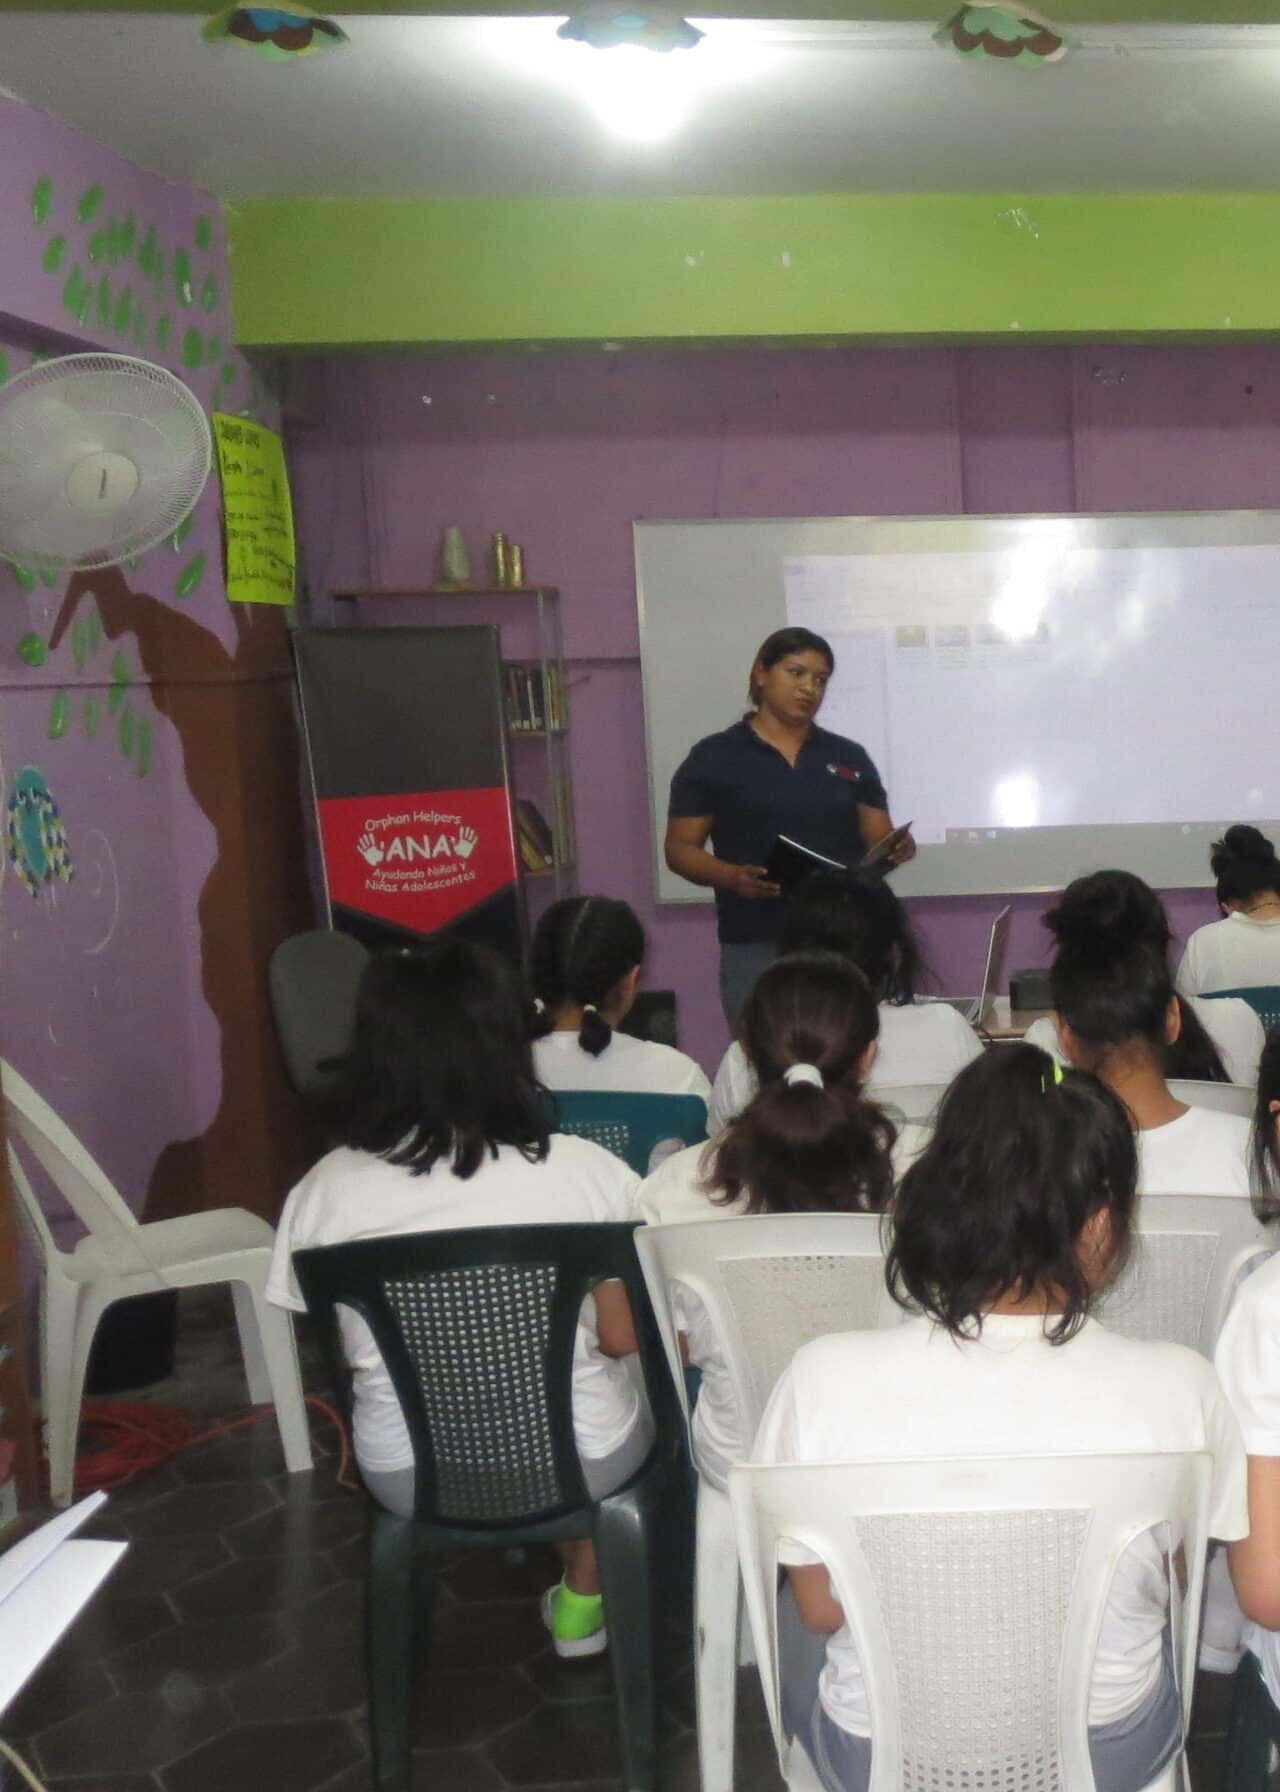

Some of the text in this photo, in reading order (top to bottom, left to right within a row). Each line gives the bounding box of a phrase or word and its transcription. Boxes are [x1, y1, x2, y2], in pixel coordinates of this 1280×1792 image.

[365, 810, 462, 831] Orphan Helpers
[386, 834, 451, 862] ANA
[373, 868, 425, 881] Ayudando
[401, 871, 476, 892] Adolescentes
